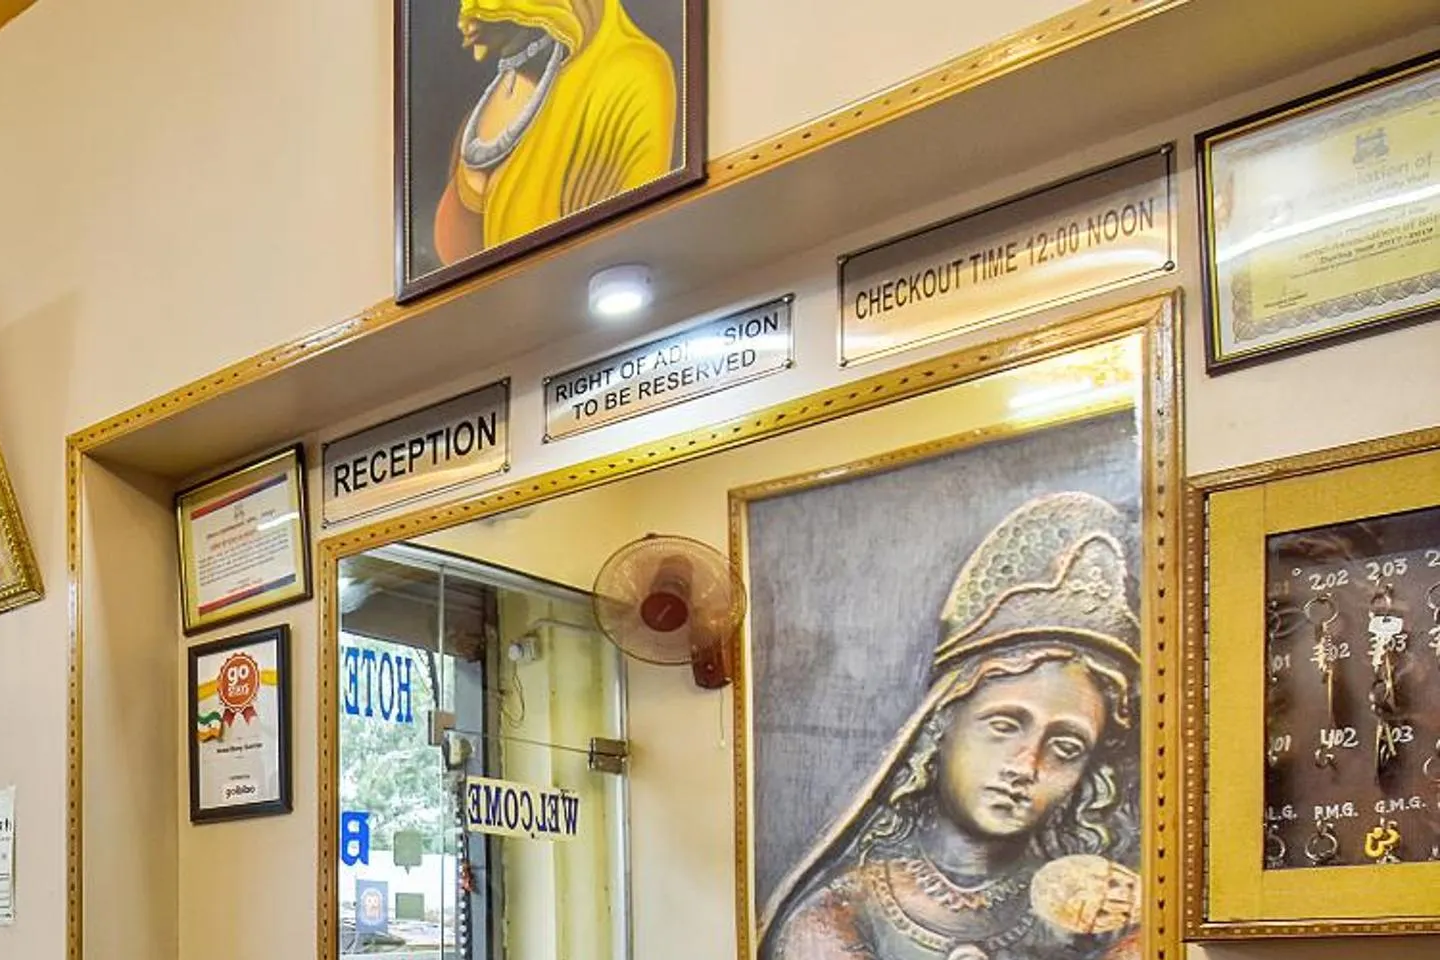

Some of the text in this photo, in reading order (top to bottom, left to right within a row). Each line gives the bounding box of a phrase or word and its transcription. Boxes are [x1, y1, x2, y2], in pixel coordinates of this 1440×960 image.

[854, 196, 1155, 320] CHECKOUT TIME 12:00 NOON
[555, 312, 780, 403] RIGHT OF ADSION
[571, 348, 757, 421] TO BE RESERVED
[333, 411, 498, 498] RECEPTION
[1308, 569, 1350, 591] 202
[1365, 558, 1408, 581] 203
[228, 664, 249, 686] go
[1320, 727, 1359, 748] 402
